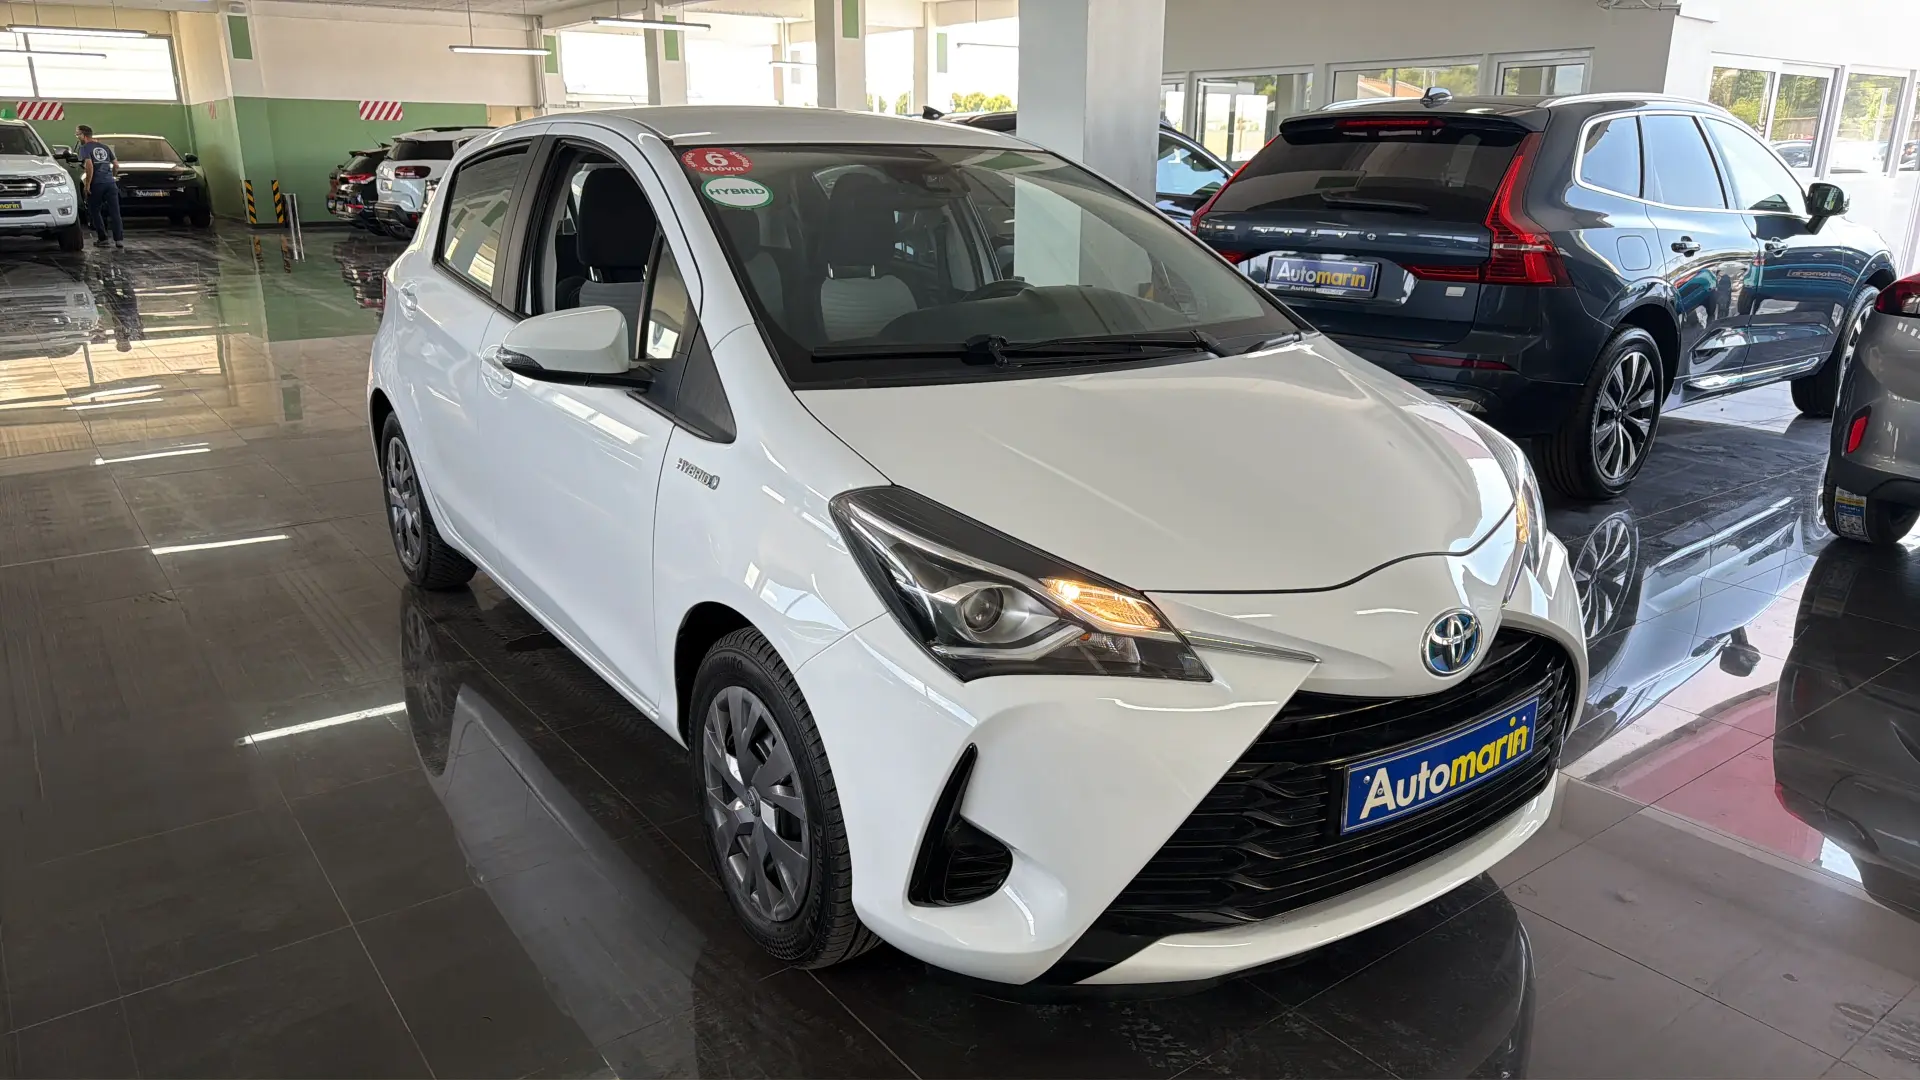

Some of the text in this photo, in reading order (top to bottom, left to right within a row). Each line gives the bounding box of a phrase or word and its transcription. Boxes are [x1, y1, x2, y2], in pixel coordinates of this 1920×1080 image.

[705, 153, 729, 167] 6
[1276, 261, 1366, 288] Automarin
[1290, 285, 1345, 296] Autom.gr
[1359, 716, 1529, 820] Automarin
